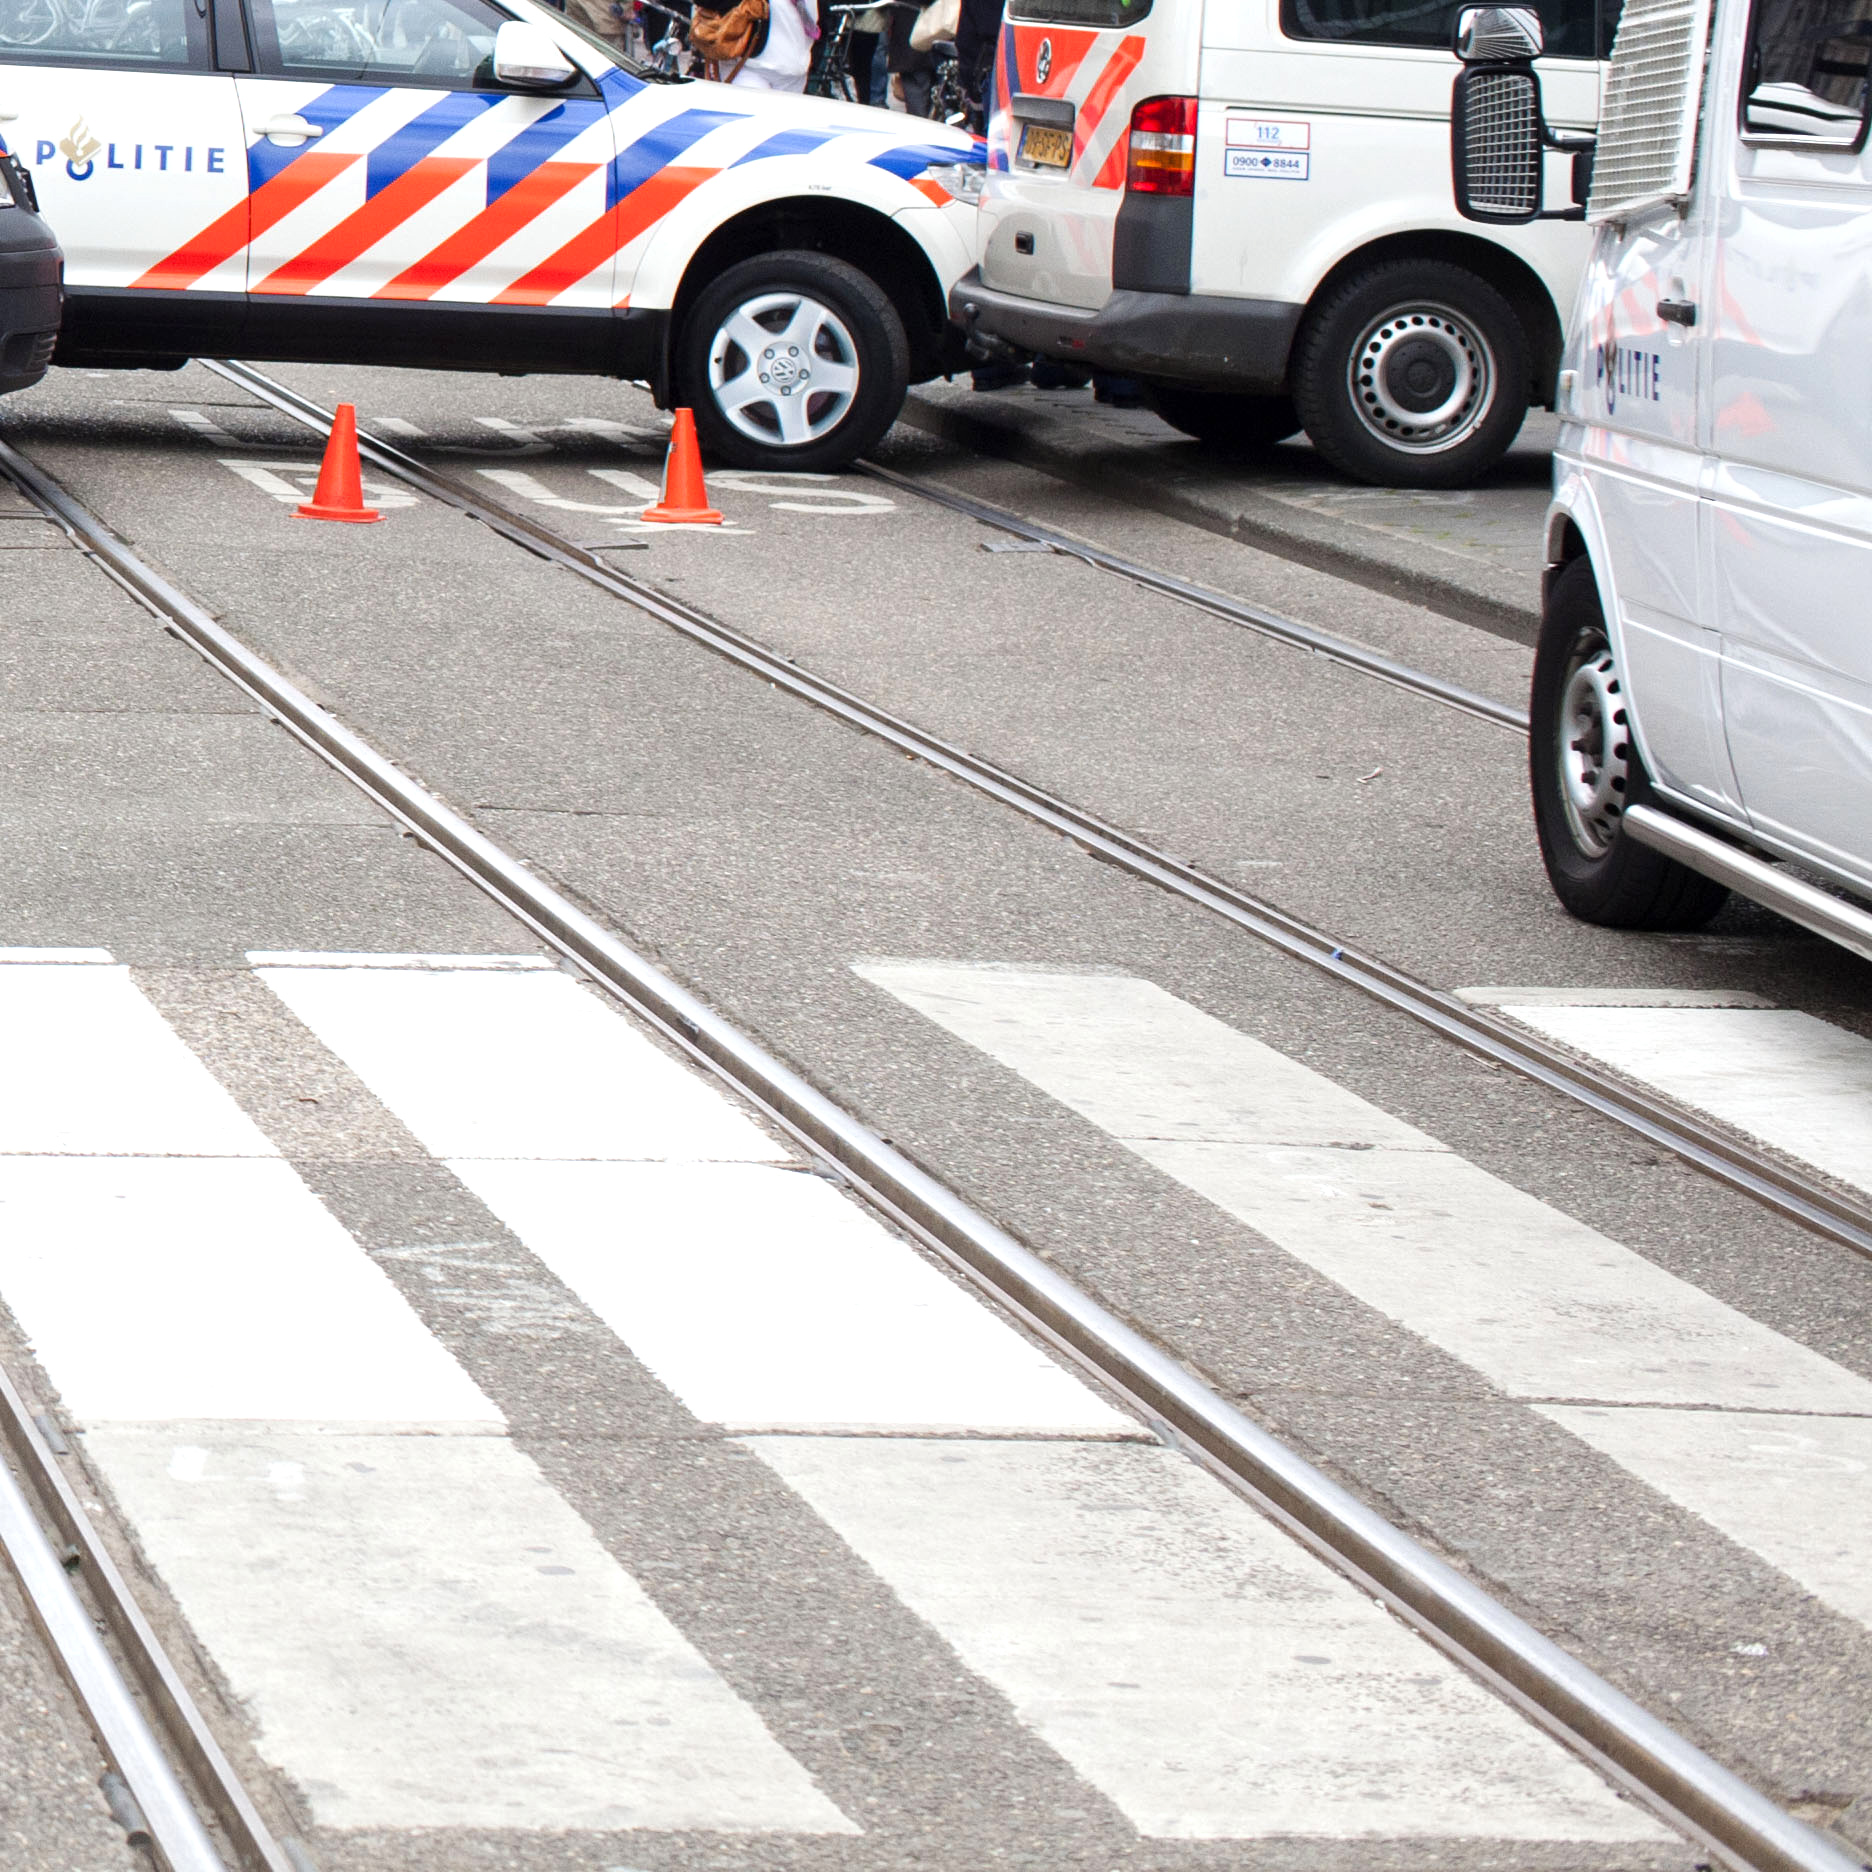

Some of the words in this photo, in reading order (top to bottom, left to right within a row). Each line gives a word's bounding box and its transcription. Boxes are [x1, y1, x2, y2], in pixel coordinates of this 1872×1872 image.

[1257, 126, 1280, 140] 112
[35, 139, 225, 181] POLITIE
[1232, 156, 1259, 167] 0900
[1272, 158, 1300, 169] 8844
[1596, 343, 1661, 416] POLITIE
